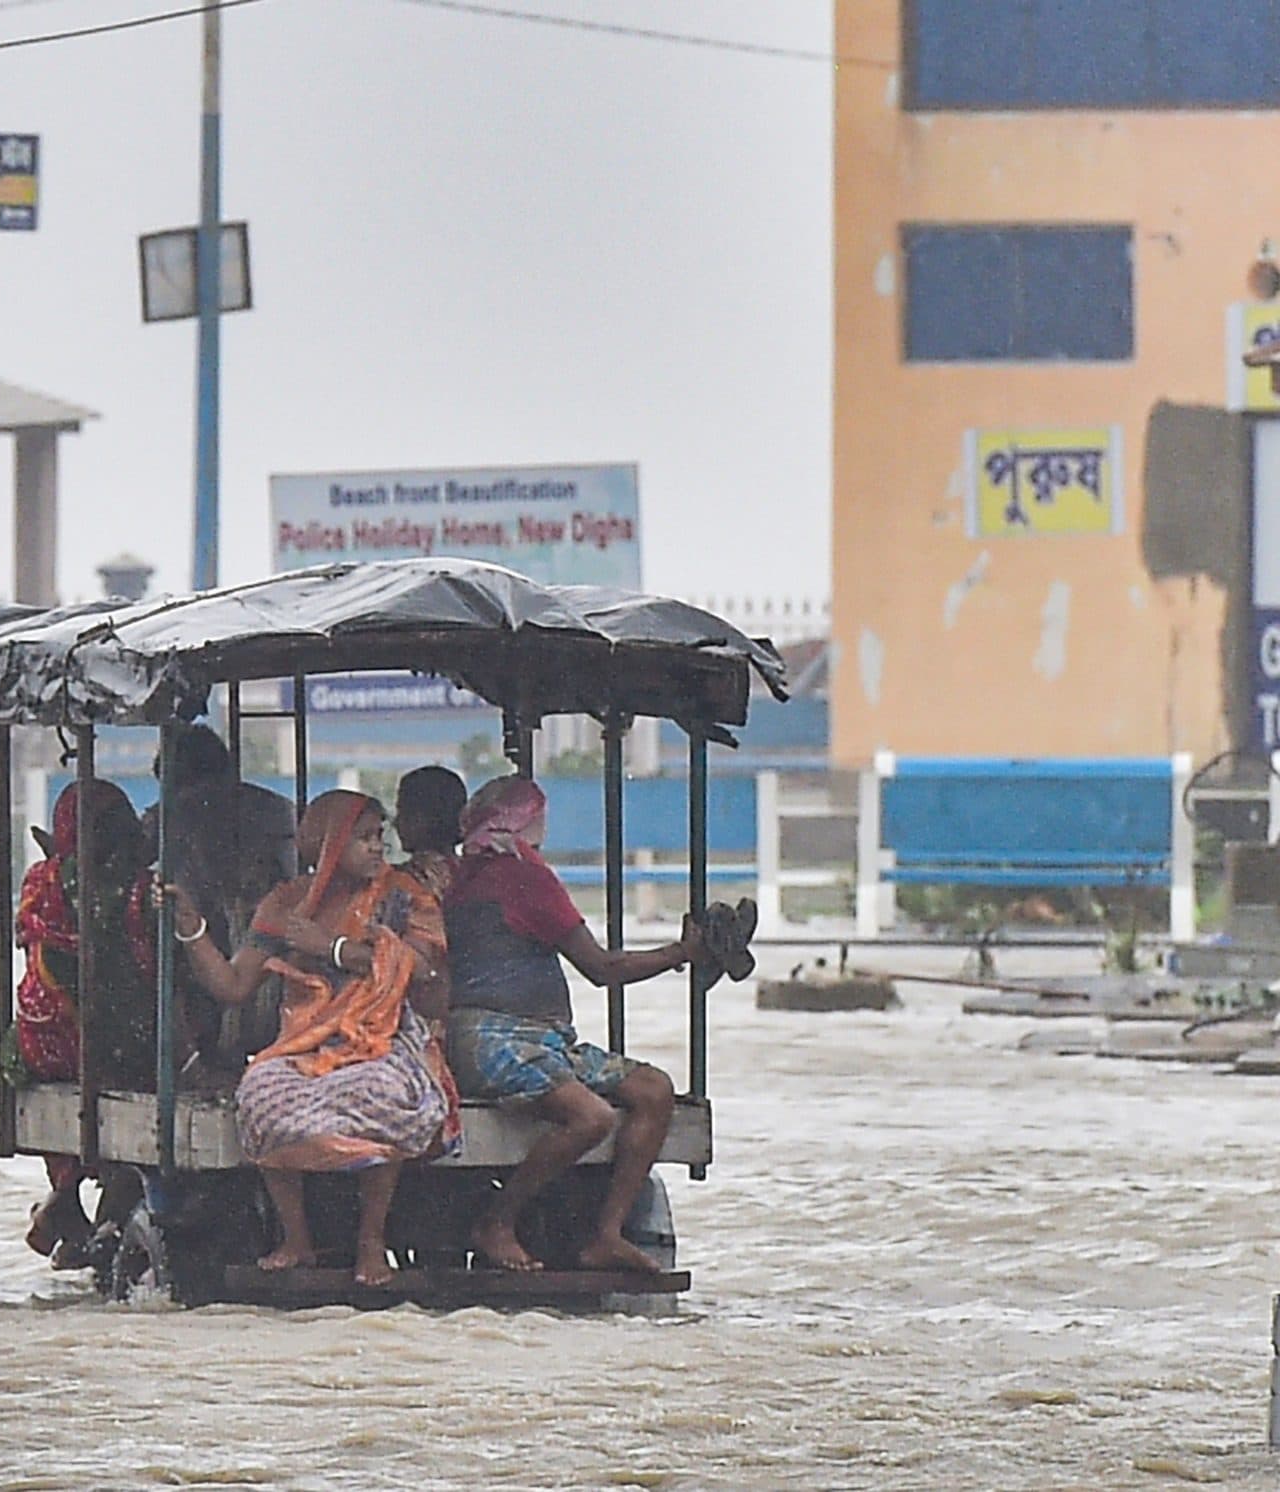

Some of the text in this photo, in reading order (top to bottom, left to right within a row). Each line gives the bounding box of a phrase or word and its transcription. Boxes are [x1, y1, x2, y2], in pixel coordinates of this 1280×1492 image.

[329, 477, 578, 507] Beach front Beautification
[278, 519, 345, 551] Police
[352, 515, 435, 558] Holiday
[518, 512, 566, 544] New
[572, 510, 634, 549] Digha
[309, 683, 447, 710] Government
